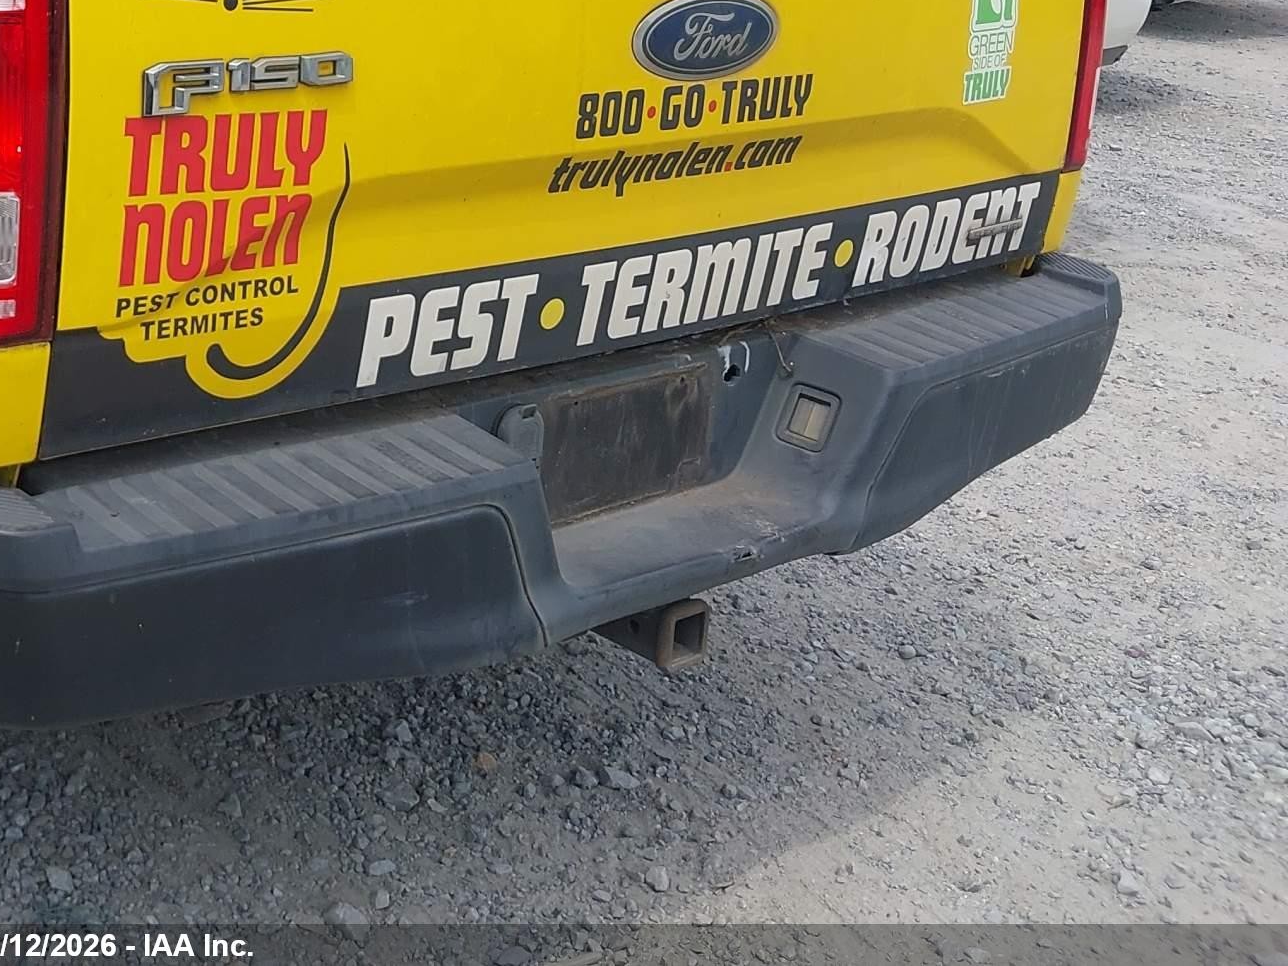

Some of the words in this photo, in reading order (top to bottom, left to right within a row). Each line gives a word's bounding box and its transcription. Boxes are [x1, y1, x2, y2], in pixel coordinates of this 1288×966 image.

[674, 12, 752, 61] Ford
[969, 32, 1013, 57] GREEN
[973, 55, 993, 70] SIDE
[993, 53, 1006, 68] OF
[964, 68, 1010, 103] TRULY
[124, 109, 327, 197] TRULY
[548, 135, 803, 197] trulynolen.com
[119, 193, 312, 287] NOLEN
[116, 292, 180, 318] PEST
[185, 275, 299, 307] CONTROL
[355, 273, 540, 387] PEST
[575, 237, 832, 347] TERMITE
[852, 181, 1042, 288] RODENT
[140, 307, 264, 341] TERMITES
